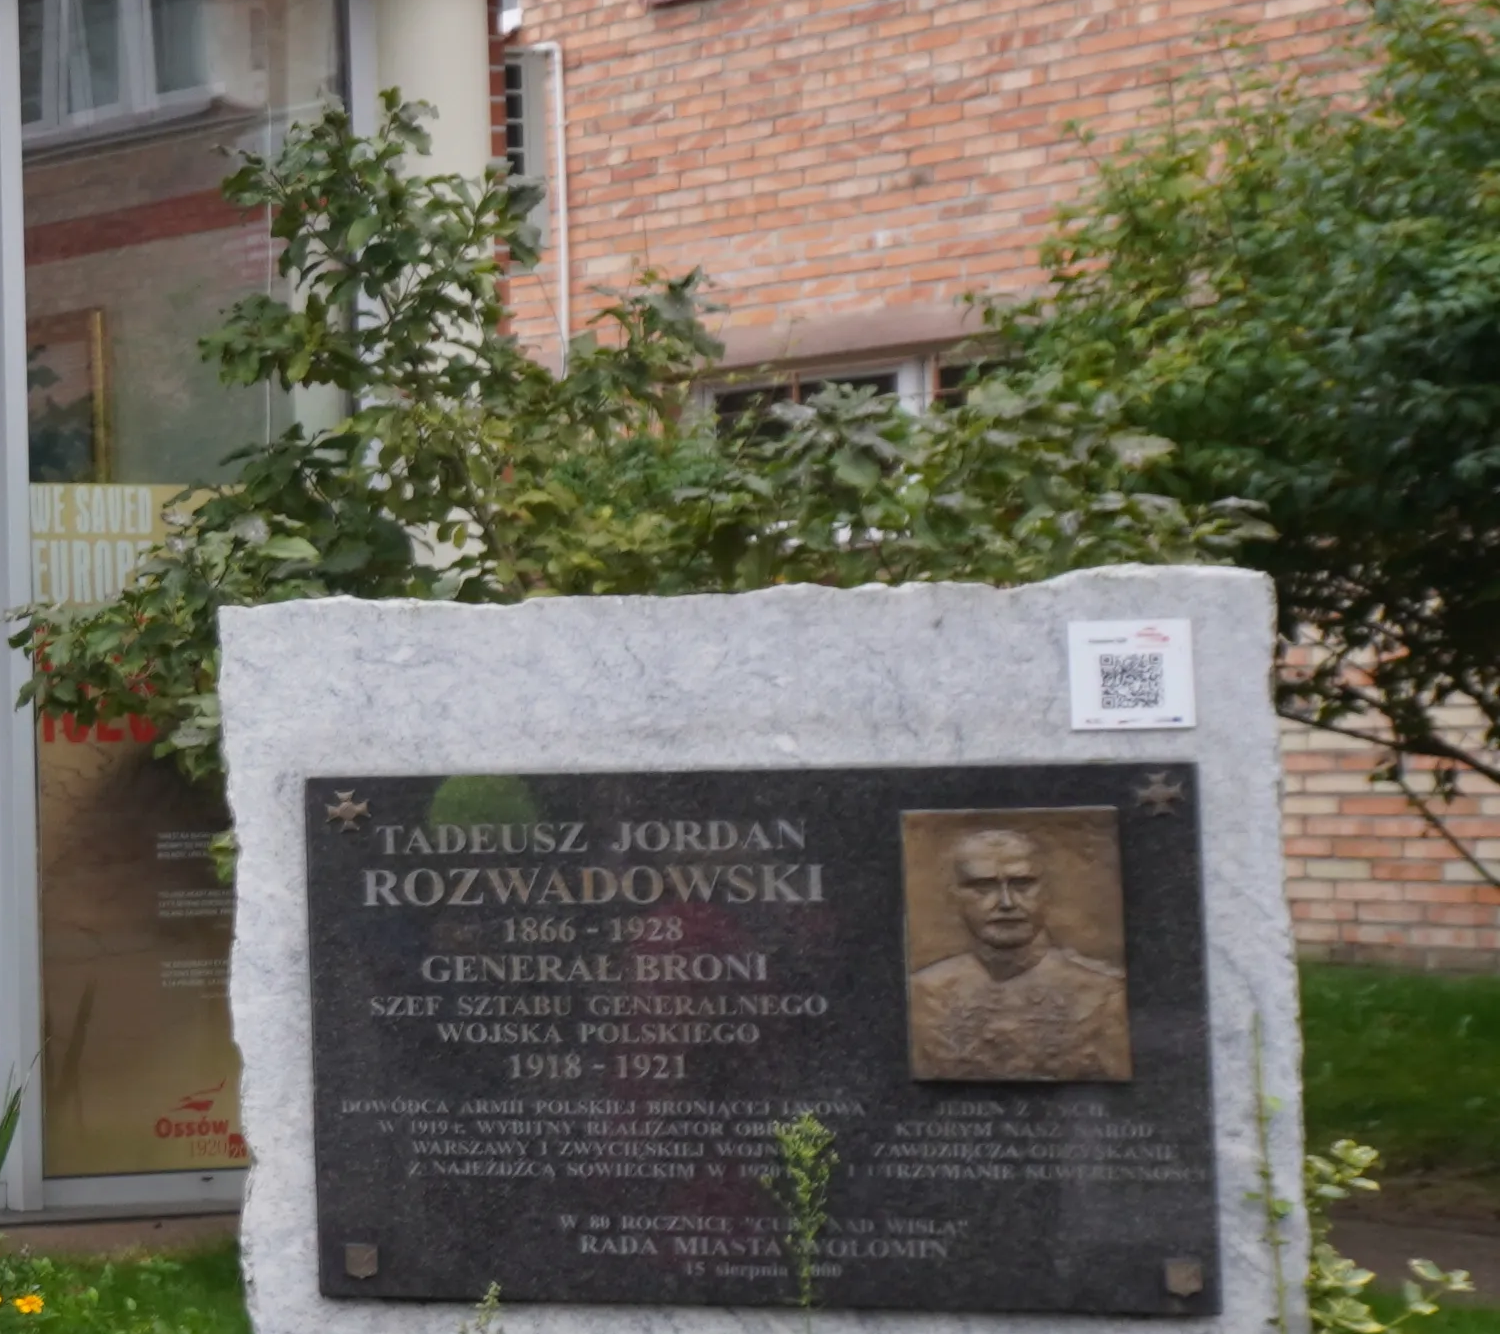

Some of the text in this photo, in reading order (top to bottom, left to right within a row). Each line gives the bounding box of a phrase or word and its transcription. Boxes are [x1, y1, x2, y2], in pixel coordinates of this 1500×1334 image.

[30, 485, 153, 534] WE SAVED
[376, 818, 808, 856] TADEUSZ JORDAN
[363, 863, 827, 907] ROZWADOWSKI
[503, 917, 576, 943] 1866
[610, 916, 685, 943] 1928
[421, 952, 768, 983] GENERAŁ BRONI
[370, 995, 828, 1017] SZEF SZTABU GENERALNEGO
[437, 1022, 760, 1043] WOJSKA POLSKIEGO
[508, 1053, 582, 1079] 1918
[616, 1053, 688, 1079] 1921
[341, 1096, 449, 1114] DOWÓDCA
[461, 1099, 524, 1114] ARMII
[535, 1099, 635, 1115] POLSKIEJ
[154, 1116, 229, 1138] Ossów
[409, 1120, 448, 1135] 1919
[477, 1120, 575, 1135] WYBITNY
[587, 1120, 724, 1136] REALIZATOR
[412, 1140, 529, 1156] WARSZAWY
[408, 1162, 422, 1177] Z
[567, 1163, 695, 1178] SOWIECKIM
[708, 1164, 725, 1178] W
[580, 1234, 659, 1255] RADA
[674, 1235, 782, 1257] MIASTA
[716, 1260, 789, 1280] sierpnia
